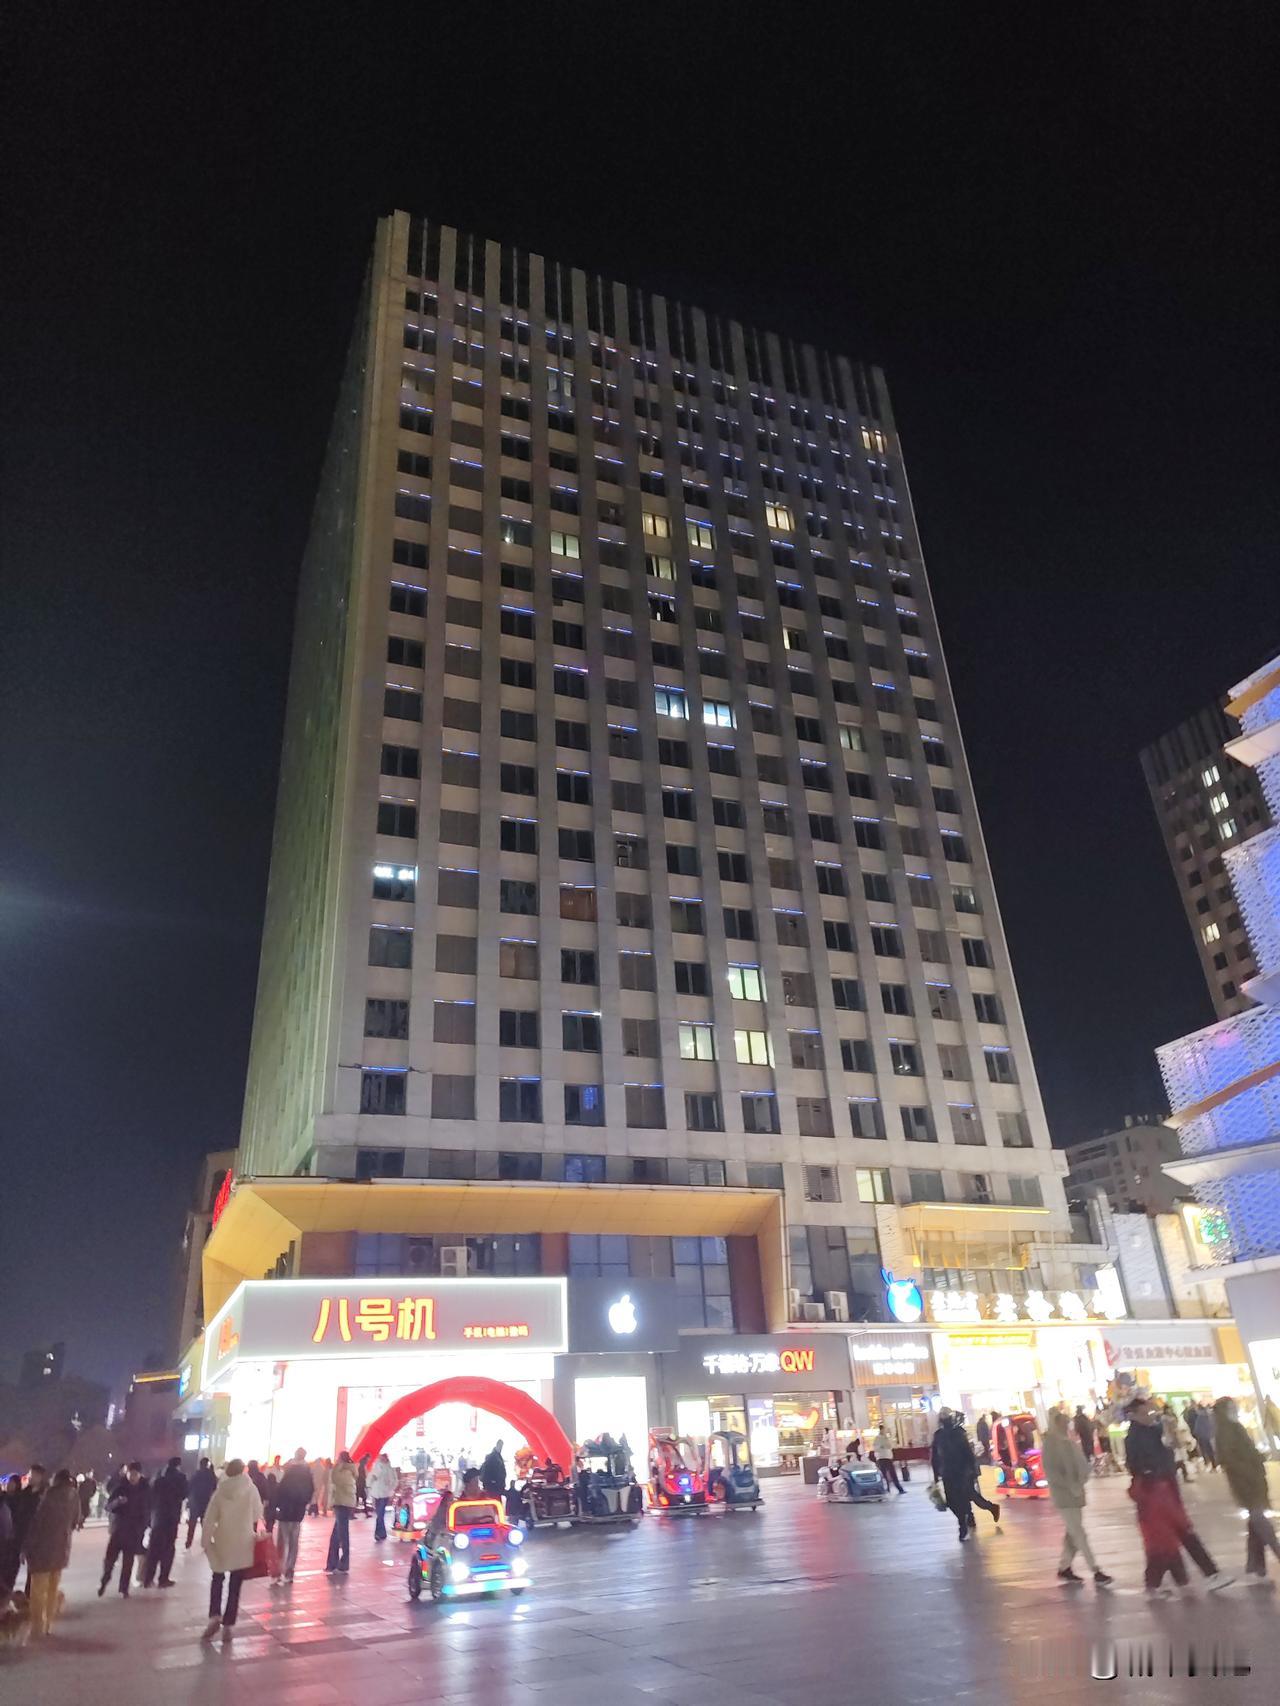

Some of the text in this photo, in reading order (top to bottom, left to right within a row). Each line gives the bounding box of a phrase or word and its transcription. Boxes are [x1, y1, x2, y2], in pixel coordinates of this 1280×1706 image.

[312, 1296, 437, 1343] 八号机
[780, 1350, 815, 1373] QW
